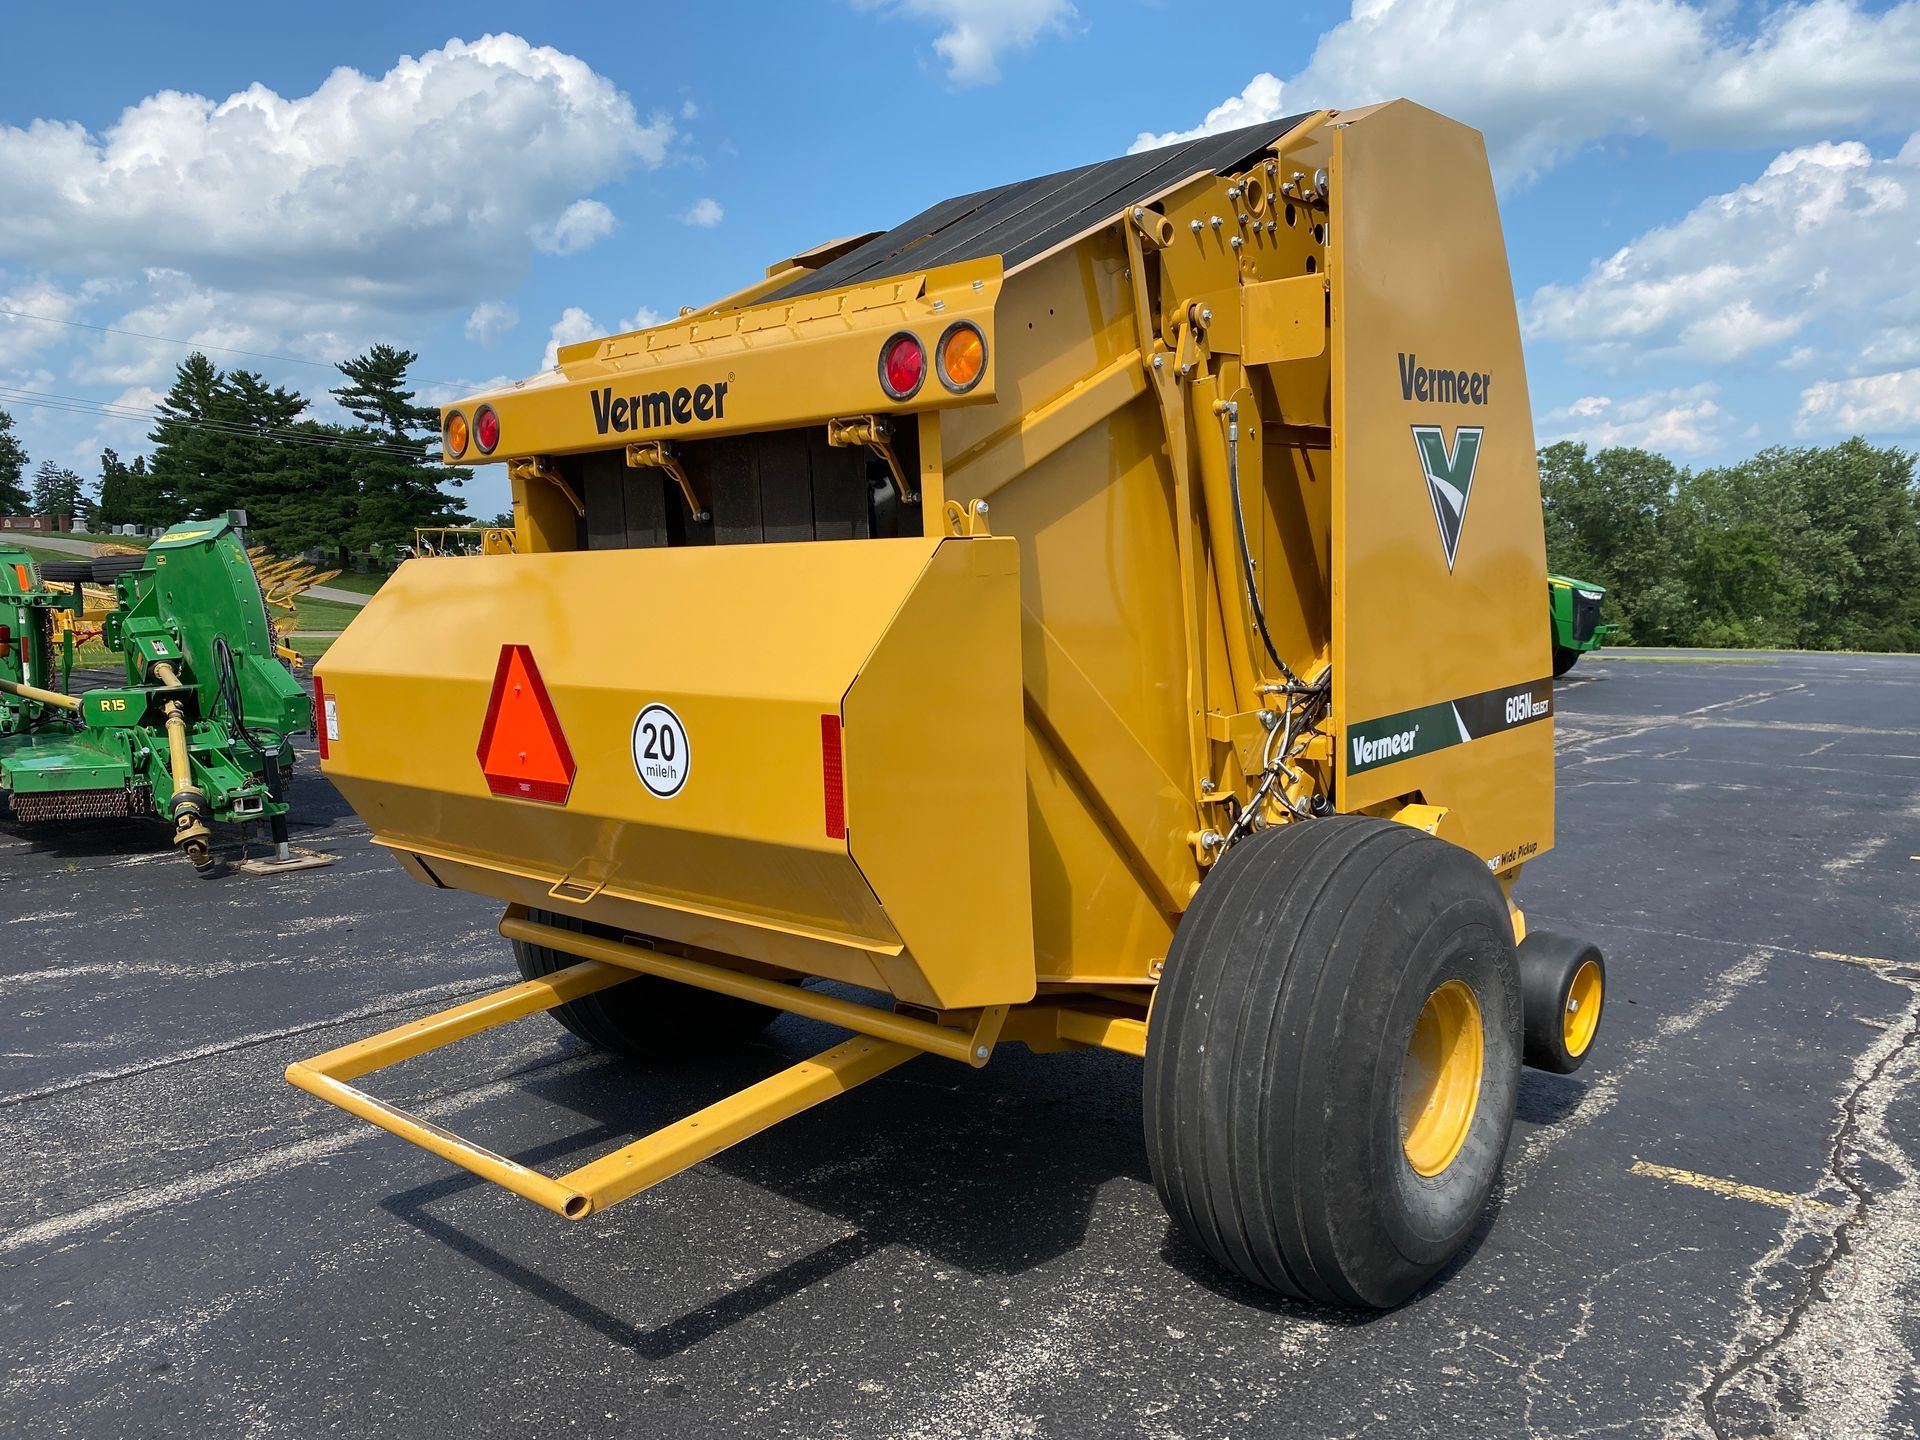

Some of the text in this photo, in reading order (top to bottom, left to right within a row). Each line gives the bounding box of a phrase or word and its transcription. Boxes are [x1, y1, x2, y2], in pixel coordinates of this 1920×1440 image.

[1397, 352, 1490, 405] Vermeer
[590, 381, 728, 435] Vermeer
[1505, 691, 1550, 724] 605N SELECT
[642, 722, 675, 762] 20
[1352, 730, 1416, 766] Vermeer
[646, 763, 677, 779] mile/h
[1501, 849, 1517, 867] Wide
[1517, 841, 1538, 860] Pickup
